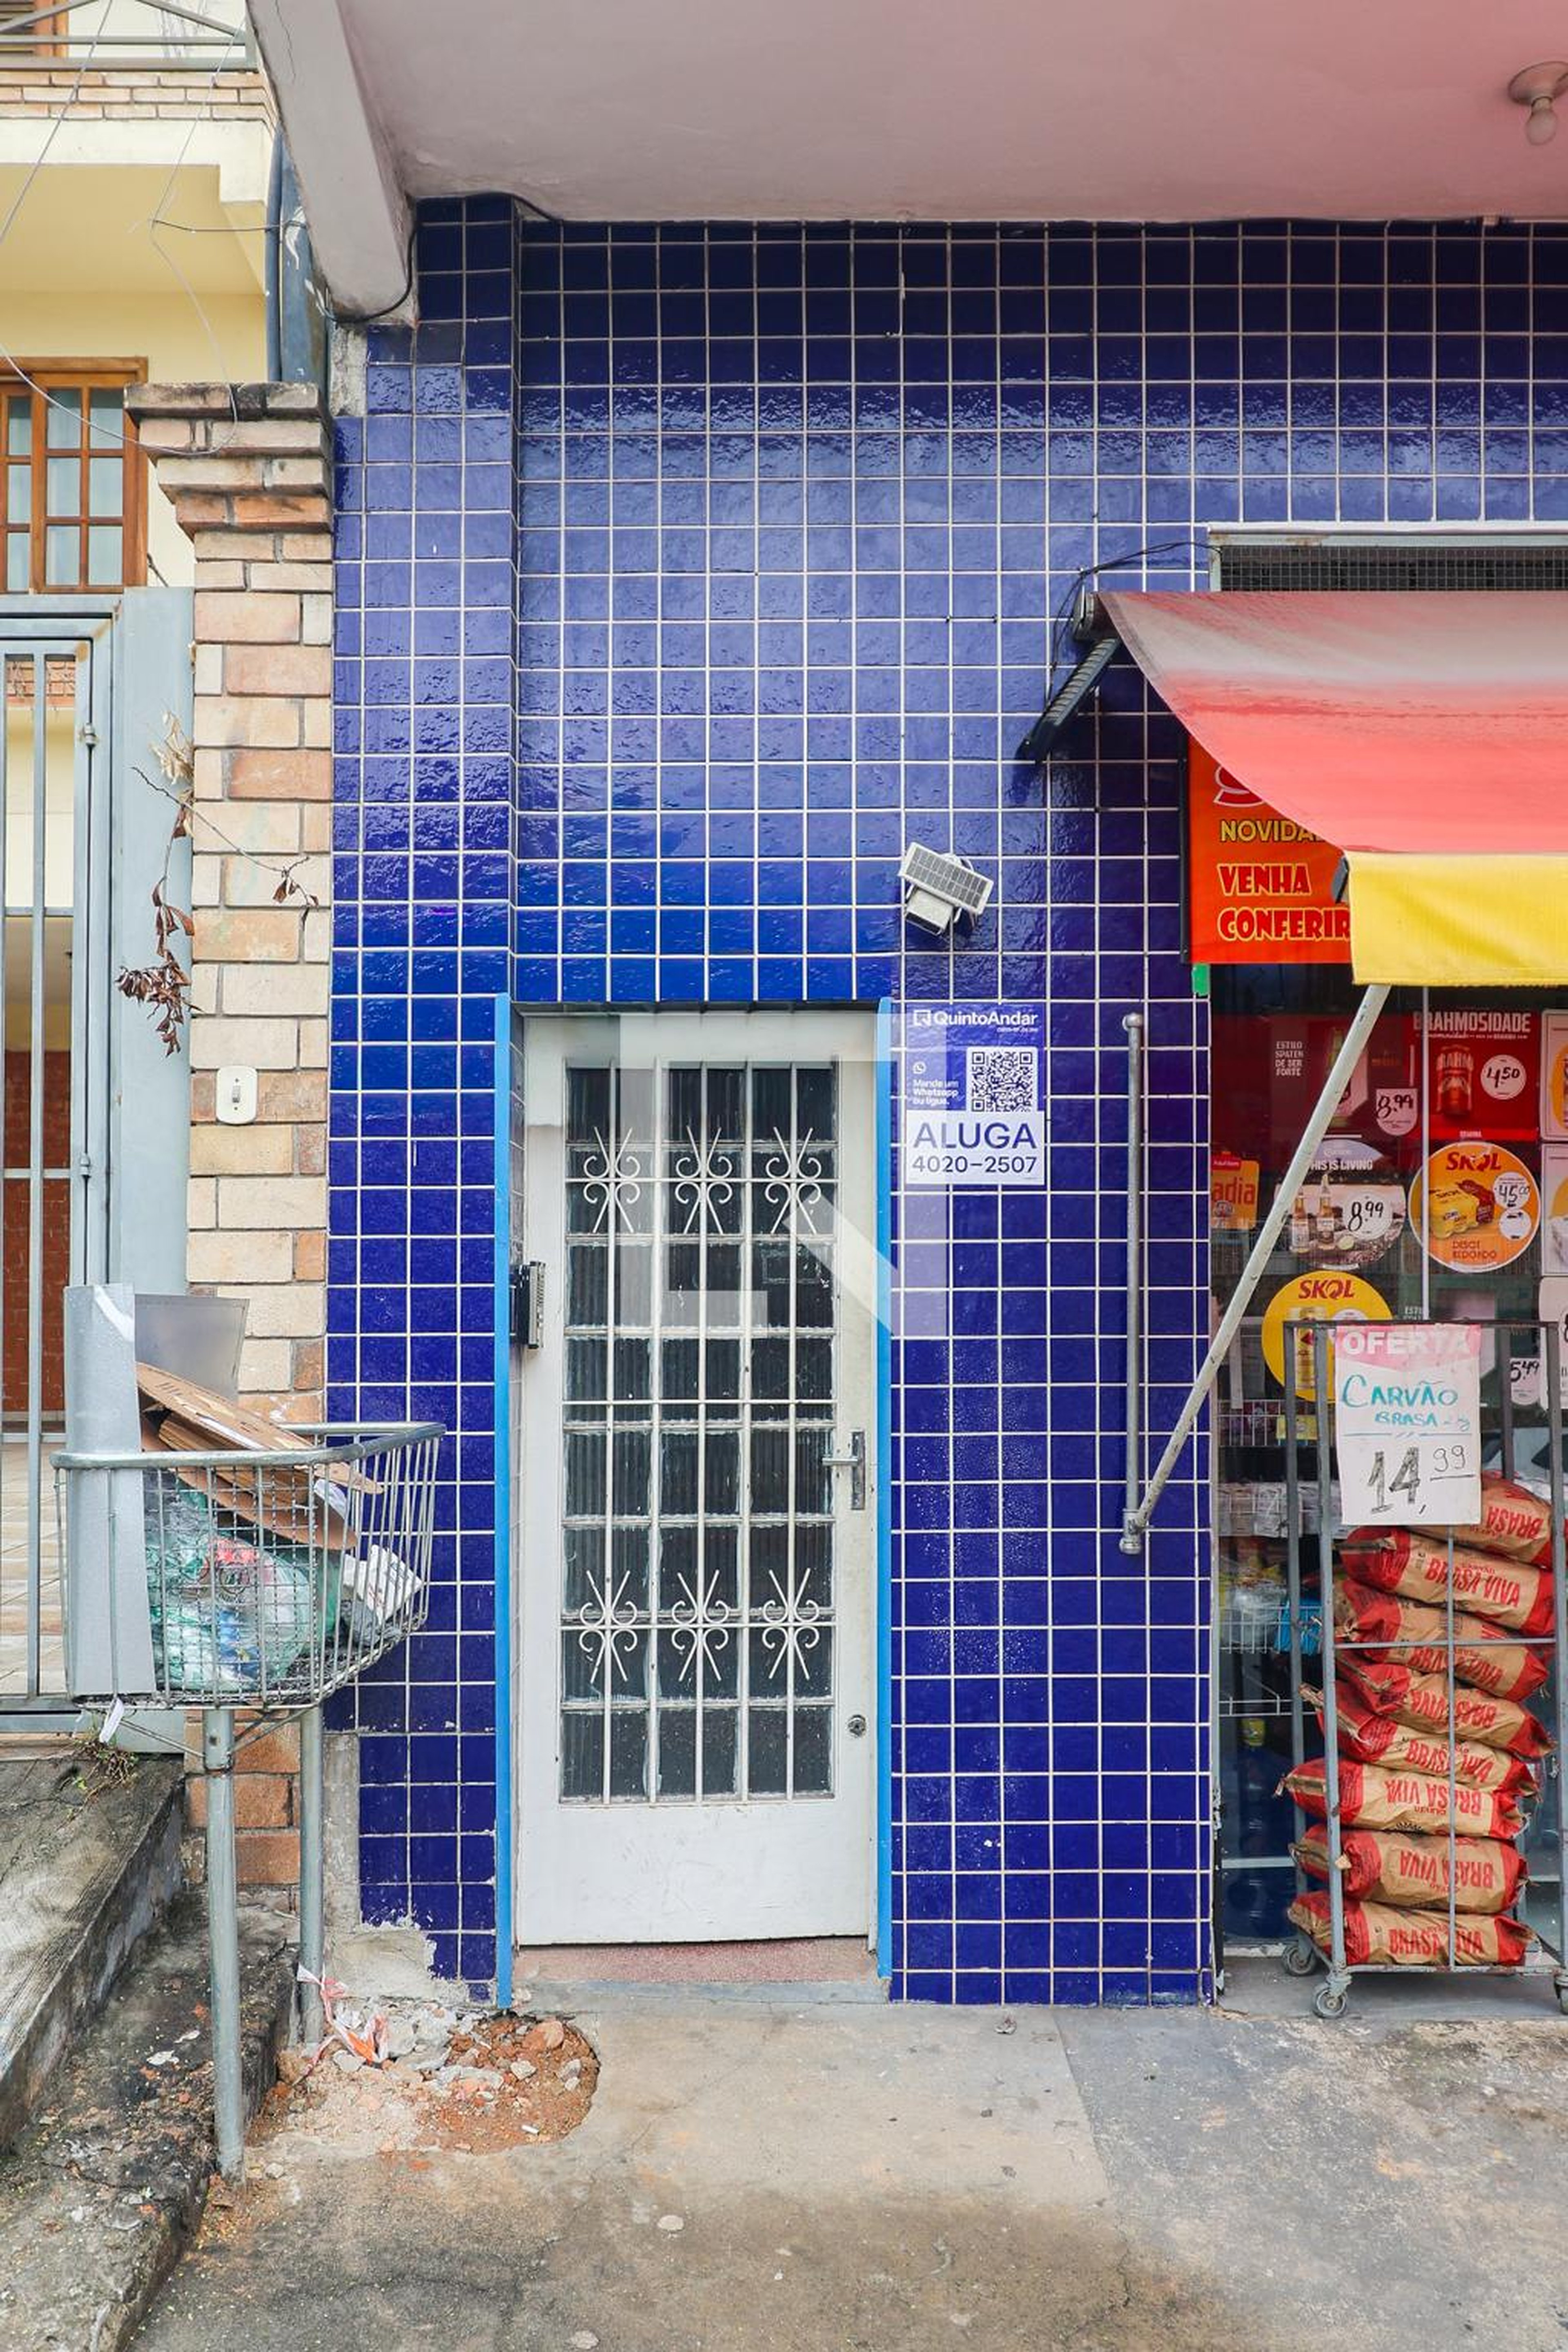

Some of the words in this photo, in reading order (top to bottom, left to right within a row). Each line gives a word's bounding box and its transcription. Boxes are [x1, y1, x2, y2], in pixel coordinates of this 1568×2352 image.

[1220, 820, 1325, 842] NOVIDA
[1217, 863, 1312, 896] VENHA
[1217, 906, 1351, 941] CONFERIR
[933, 1011, 1038, 1026] QuintoAndar
[913, 1122, 1037, 1149] ALUGA
[913, 1156, 1037, 1173] 4020-2507
[1214, 1176, 1256, 1204] adia
[1298, 1279, 1354, 1300] SKOL
[1344, 1330, 1468, 1356] OFERTA
[1341, 1374, 1458, 1408] CARVÃO
[1374, 1411, 1438, 1427] BRASA
[1486, 1506, 1544, 1539] BRASA
[1424, 1558, 1482, 1594] BRASA
[1483, 1575, 1520, 1608] VIVA
[1405, 1740, 1448, 1774] BRAS
[1385, 1779, 1420, 1804] VIVA
[1401, 1850, 1437, 1883] VIVA
